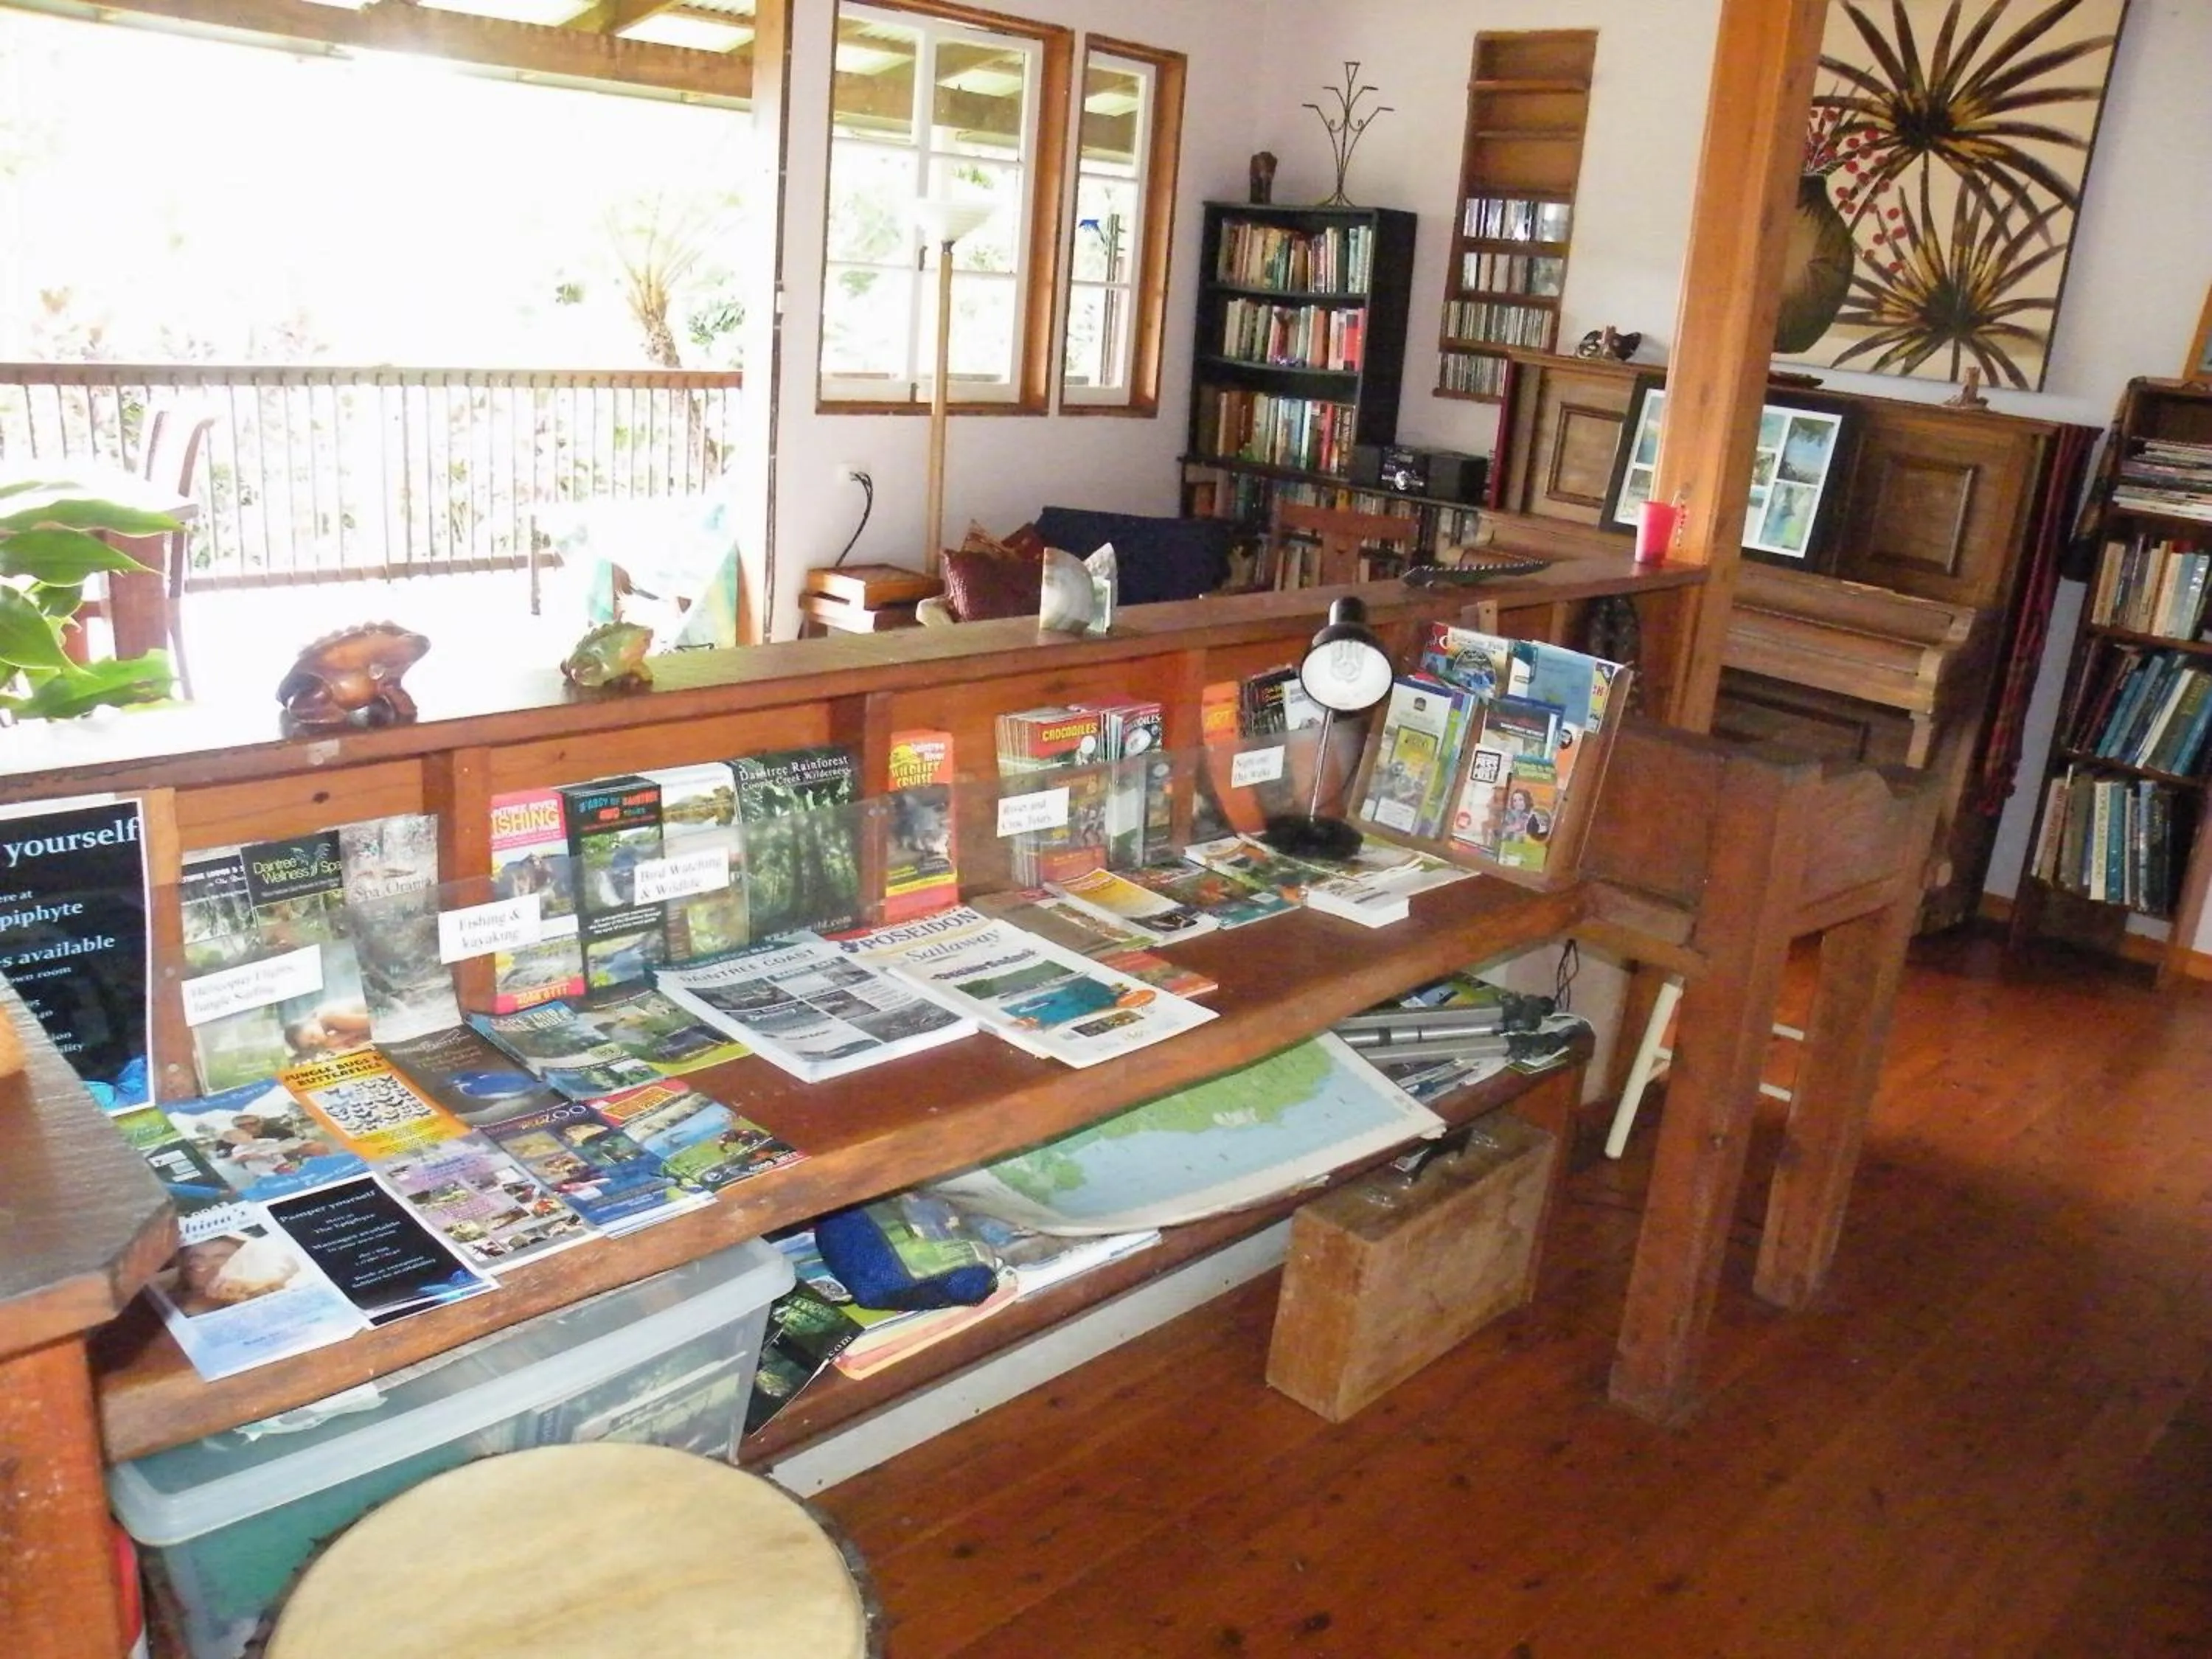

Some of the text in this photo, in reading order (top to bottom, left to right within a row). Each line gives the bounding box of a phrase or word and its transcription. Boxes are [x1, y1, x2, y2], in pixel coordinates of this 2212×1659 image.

[1042, 722, 1097, 742] CROCODILES
[740, 756, 849, 782] Daintree Rainforest
[3, 816, 140, 868] yourself
[253, 858, 297, 874] Daintree
[262, 866, 310, 885] Wellness
[321, 860, 343, 874] Spa
[669, 857, 723, 875] Watching
[19, 890, 33, 900] at
[460, 909, 520, 931] Fishing &
[859, 910, 979, 950] POSEIDON
[18, 935, 116, 964] available
[905, 928, 1001, 962] Sailaway
[38, 966, 72, 978] room
[678, 962, 759, 984] DAINTREE
[762, 949, 815, 967] COAST
[285, 1066, 333, 1082] JUNGLE
[336, 1058, 370, 1071] BUGS
[296, 1062, 383, 1086] BUTTERFLIES
[279, 1189, 377, 1223] Pamper yourself
